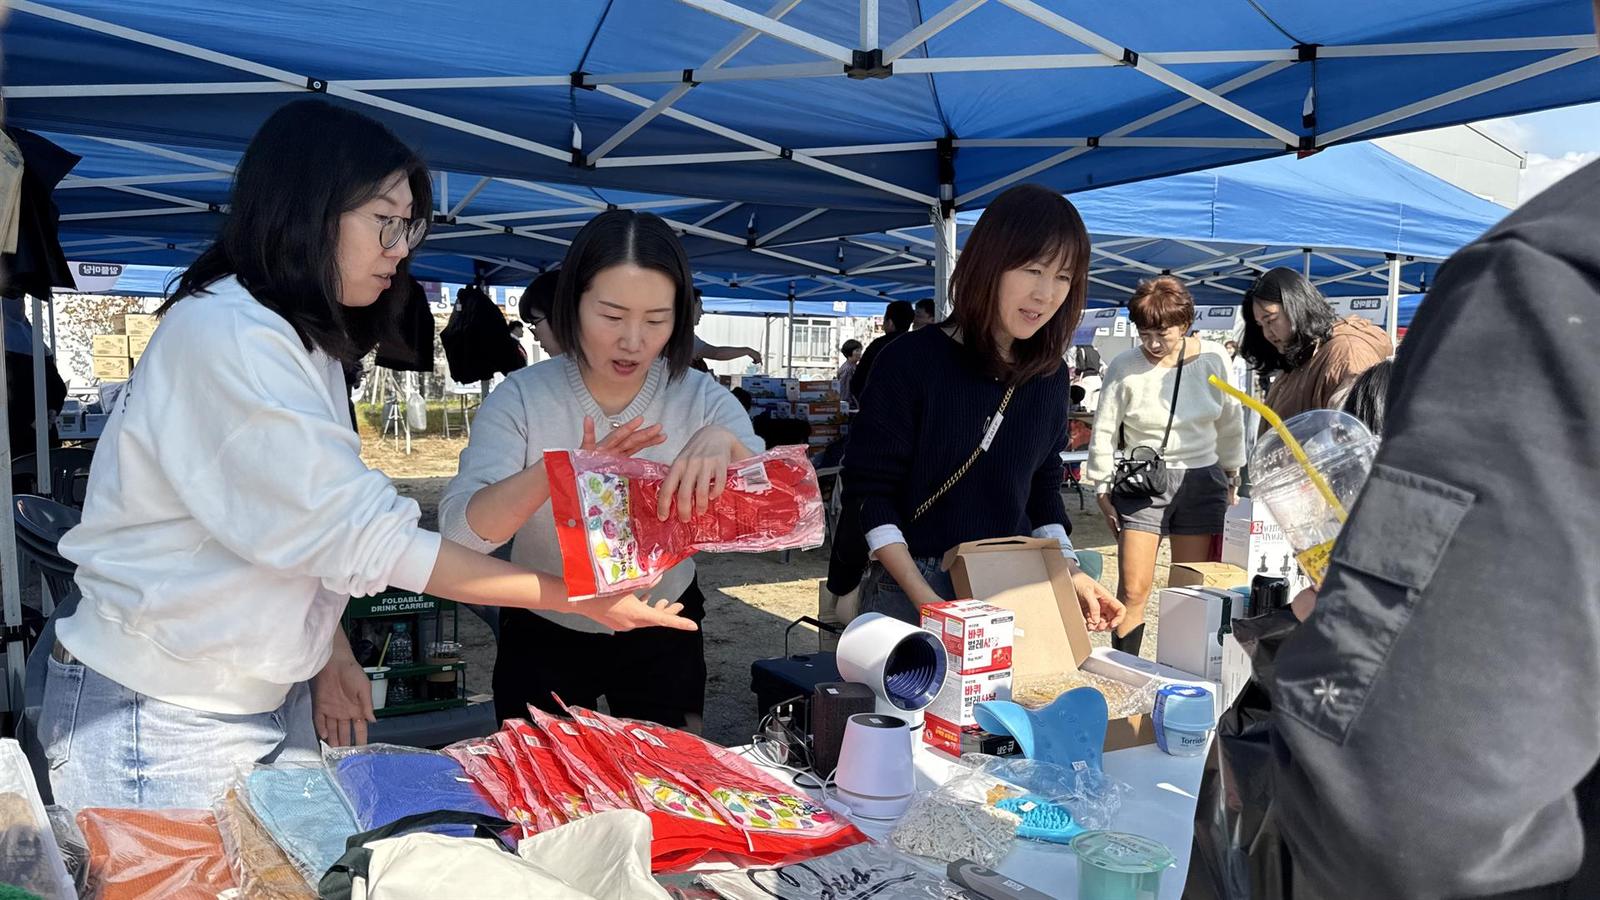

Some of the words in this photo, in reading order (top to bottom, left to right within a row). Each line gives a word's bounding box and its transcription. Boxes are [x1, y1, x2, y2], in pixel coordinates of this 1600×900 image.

[382, 595, 424, 605] FOLDABLE
[371, 604, 397, 612] DRINK
[399, 601, 434, 610] CARRIER
[967, 627, 984, 640] 바퀴
[964, 684, 981, 696] 바퀴
